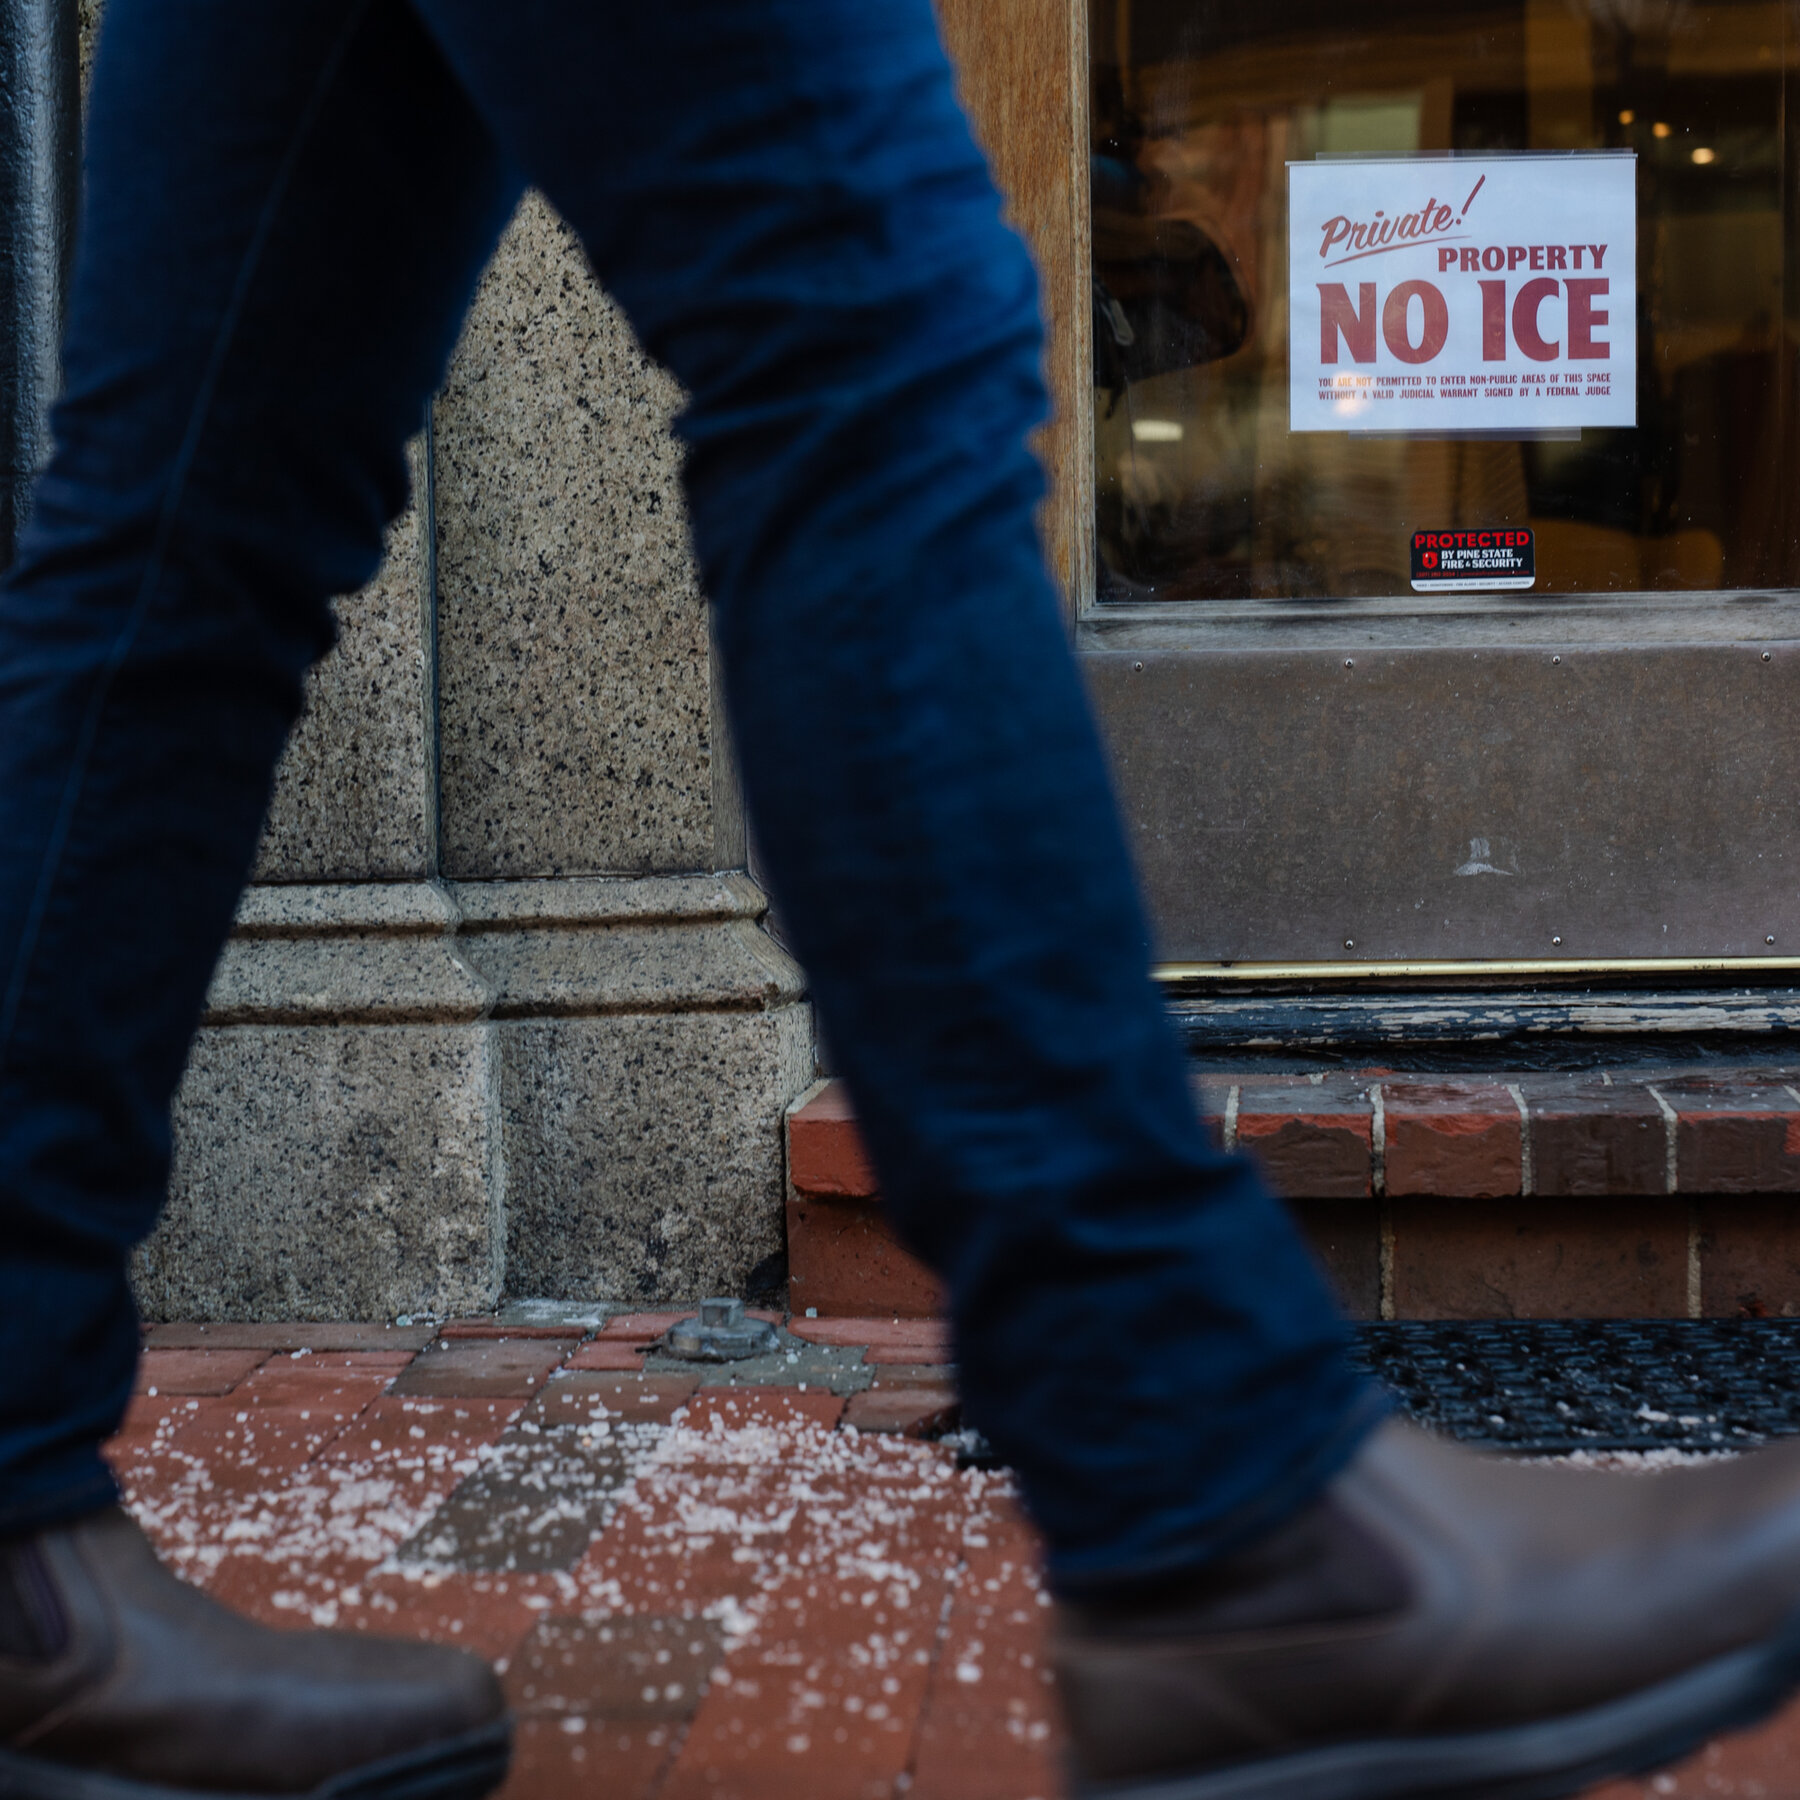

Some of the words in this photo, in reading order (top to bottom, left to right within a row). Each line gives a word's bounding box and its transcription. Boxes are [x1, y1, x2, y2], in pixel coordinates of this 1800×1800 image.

[1319, 174, 1486, 258] Private!
[1437, 244, 1608, 272] PROPERTY
[1316, 279, 1449, 365] NO
[1477, 277, 1611, 362] ICE
[1319, 377, 1334, 387] YOU
[1337, 377, 1352, 387] ARE
[1356, 376, 1372, 387] NOT
[1376, 376, 1422, 386] PERMITTED
[1426, 376, 1436, 386] TO
[1440, 375, 1466, 385] ENTER
[1470, 375, 1518, 385] NON-PUBLIC
[1521, 374, 1546, 384] AREAS
[1549, 374, 1560, 383] OF
[1564, 373, 1583, 383] THIS
[1586, 373, 1611, 383] SPACE
[1319, 390, 1356, 400] WITHOUT
[1362, 390, 1368, 399] A
[1372, 389, 1394, 399] VALID
[1400, 389, 1435, 399] JUDICIAL
[1440, 388, 1478, 398] WARRANT
[1484, 388, 1513, 397] SIGNED
[1520, 387, 1529, 397] BY
[1535, 387, 1541, 396] A
[1546, 387, 1580, 396] FEDERAL
[1585, 386, 1611, 396] JUDGE
[1415, 531, 1529, 549] PROTECTED
[1441, 550, 1454, 559] BY
[1457, 549, 1480, 559] PINE
[1482, 548, 1513, 559] STATE
[1441, 560, 1464, 569] FIRE
[1472, 558, 1523, 569] SECURITY
